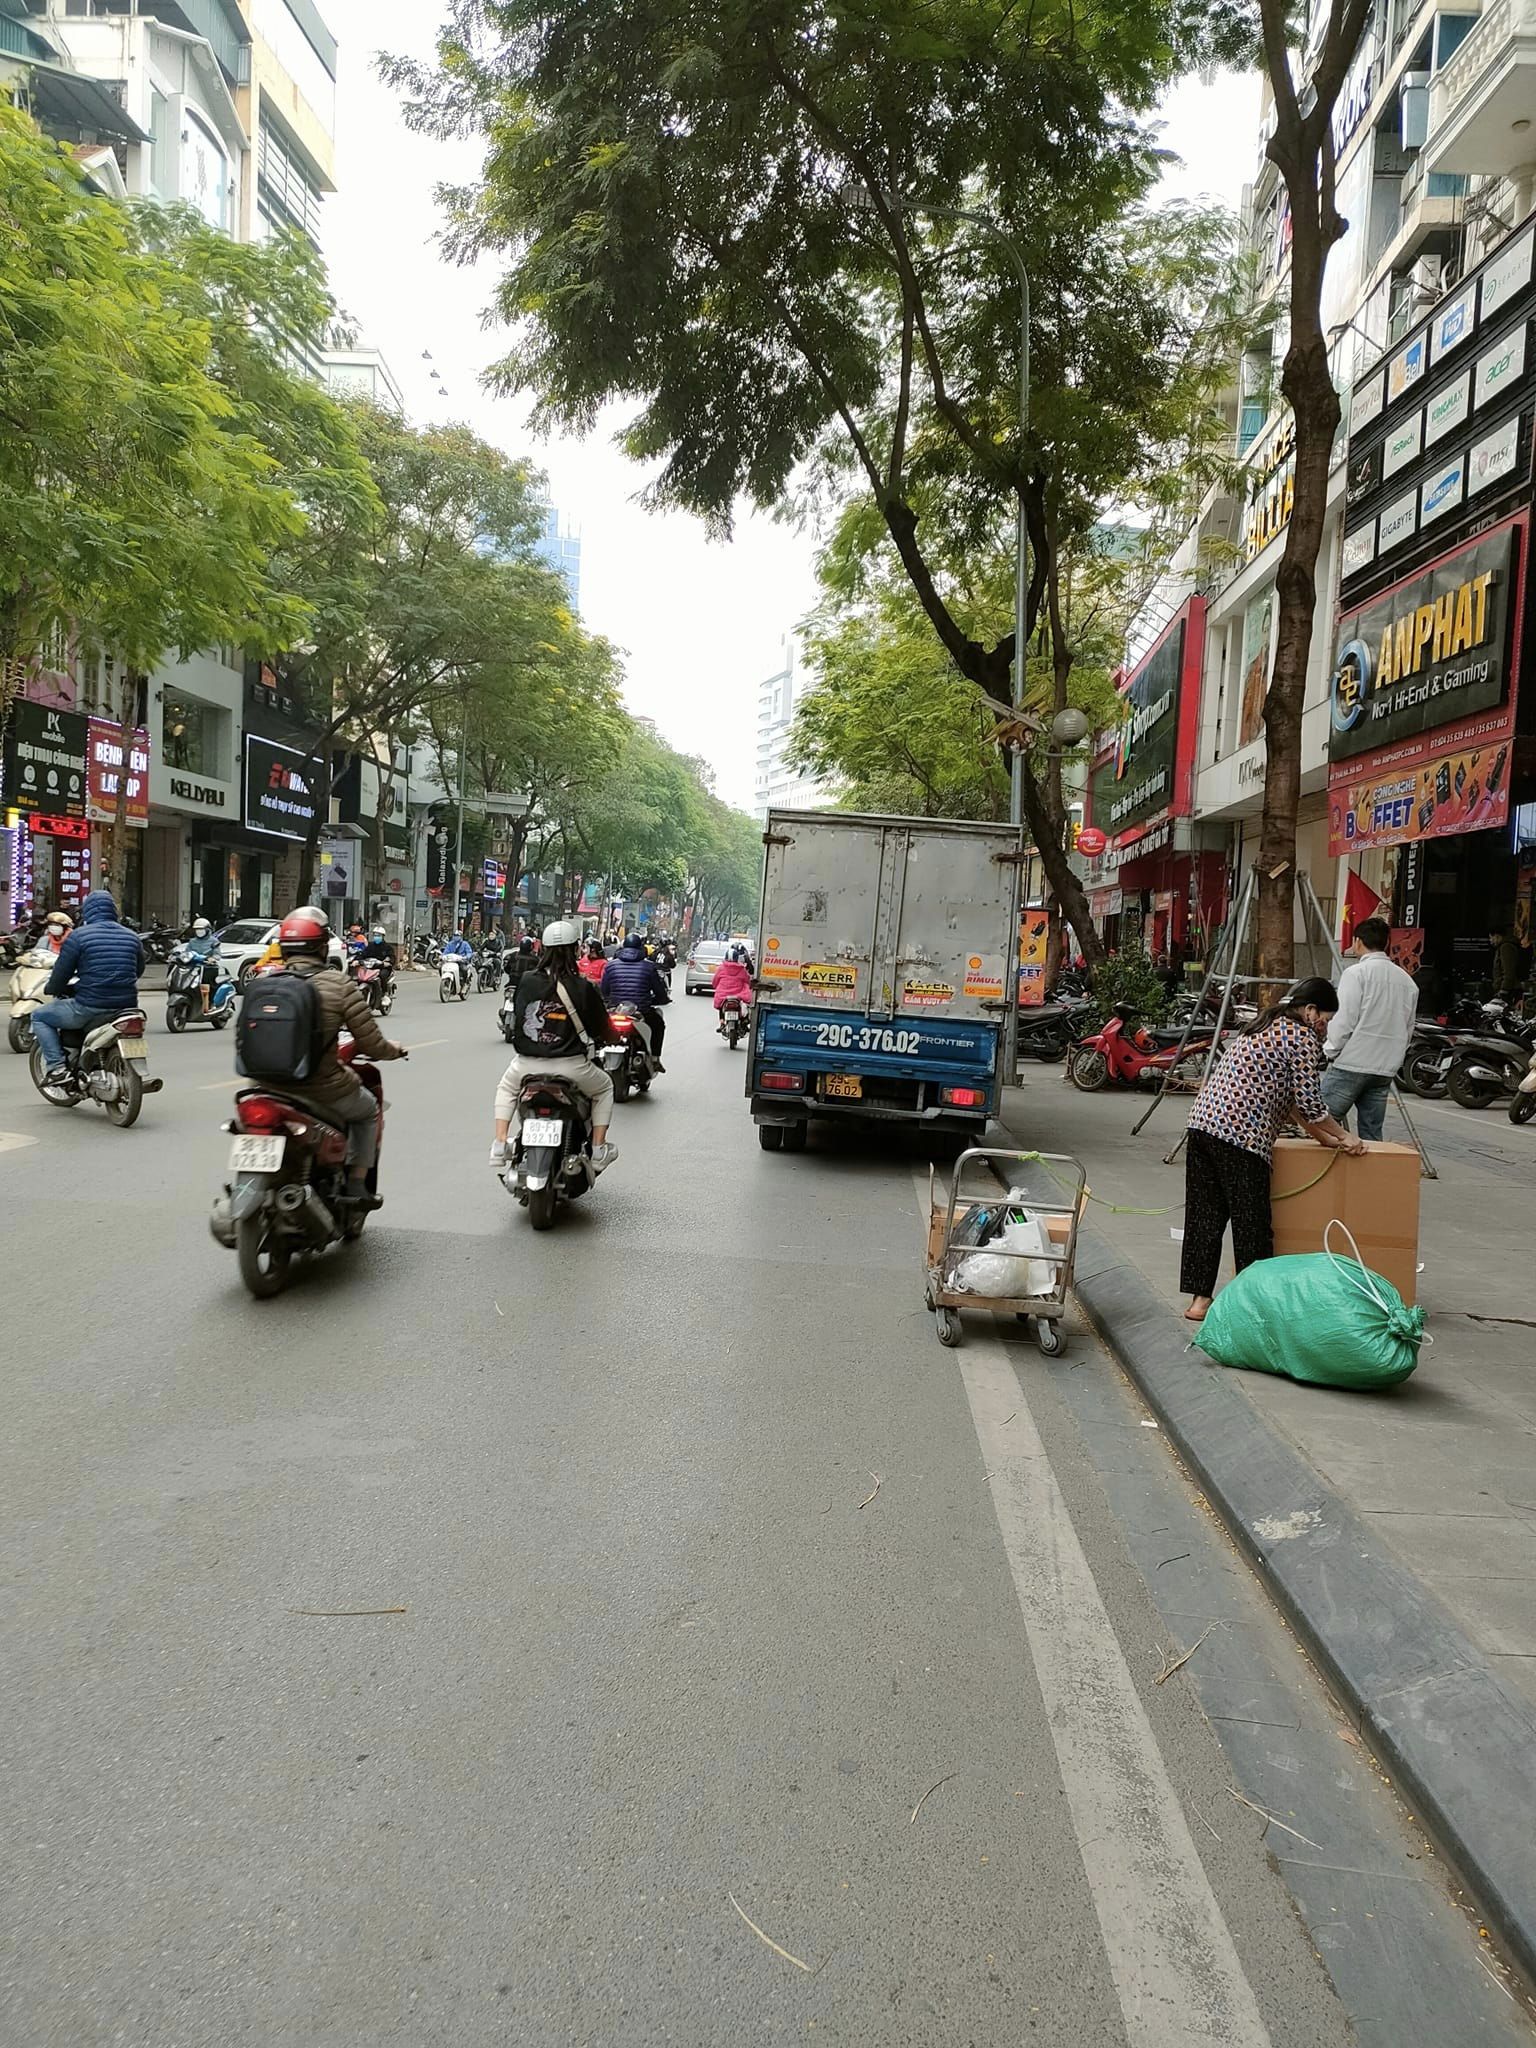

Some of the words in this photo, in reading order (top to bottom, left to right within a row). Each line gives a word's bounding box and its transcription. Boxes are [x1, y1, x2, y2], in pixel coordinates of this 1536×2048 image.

[1497, 255, 1530, 288] SEAGATE
[1485, 349, 1515, 384] acer
[1431, 387, 1465, 422] KINGMAX
[1489, 446, 1509, 468] msi
[1247, 474, 1296, 561] BILLIA
[1381, 510, 1413, 539] GIGABYTE
[1375, 570, 1492, 690] ANPHAT
[1395, 679, 1429, 711] Hi-End
[1431, 673, 1442, 696] &
[1443, 659, 1489, 689] Gaming
[42, 731, 66, 743] mobile
[95, 739, 123, 767] BỆNH
[129, 746, 147, 774] IỆN
[101, 771, 141, 798] LAOP
[170, 778, 225, 807] KELLYBUI
[1404, 840, 1419, 927] COPUTER
[764, 957, 800, 967] RIMULA
[1019, 968, 1042, 979] FET
[802, 971, 854, 984] KAYERR
[906, 979, 953, 990] KAYER
[966, 976, 1003, 985] RIMULA
[780, 1022, 818, 1033] THACO
[816, 1023, 920, 1055] 29C-376.02
[919, 1035, 975, 1048] FRONTIER
[826, 1084, 858, 1096] 76.02
